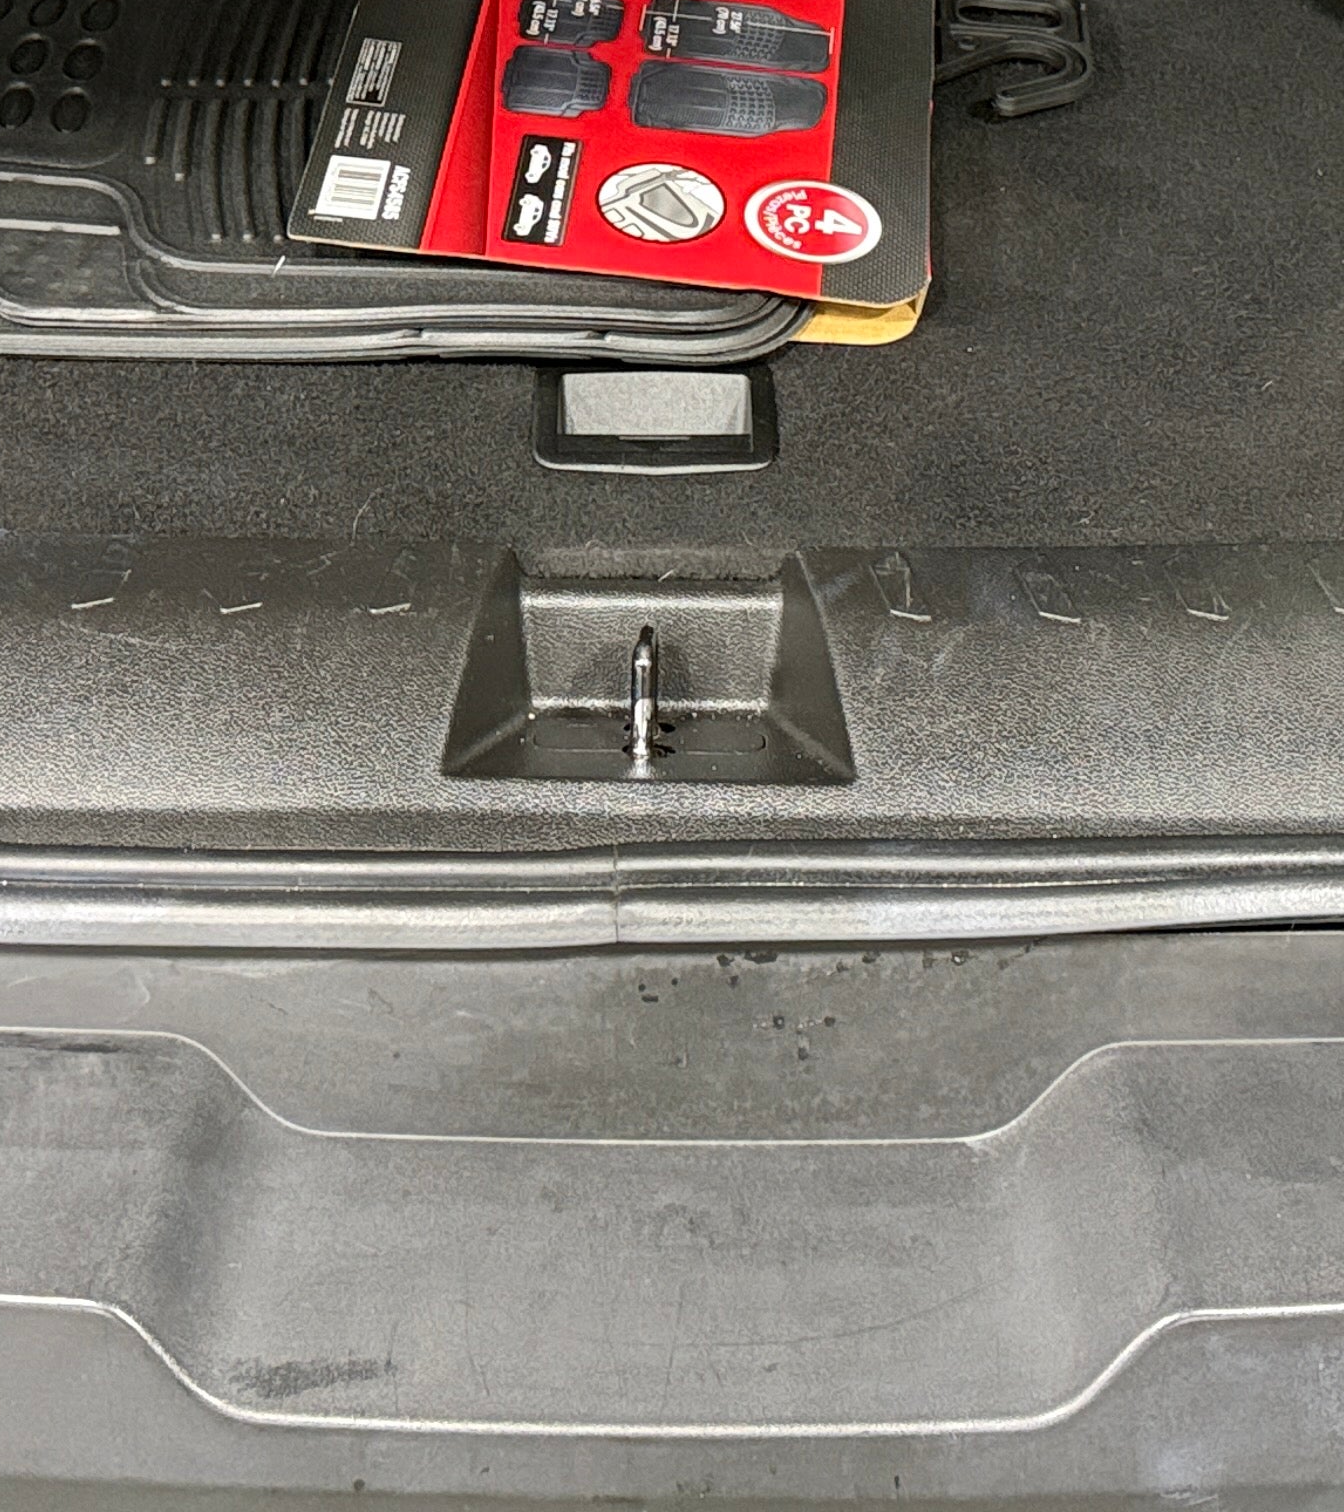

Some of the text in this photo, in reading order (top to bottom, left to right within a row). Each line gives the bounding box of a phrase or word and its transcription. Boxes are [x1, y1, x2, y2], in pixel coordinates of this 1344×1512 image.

[561, 142, 576, 157] Fits
[557, 157, 571, 179] most
[552, 179, 566, 199] cars
[549, 199, 562, 219] and
[784, 203, 812, 234] PC
[815, 209, 862, 235] 4
